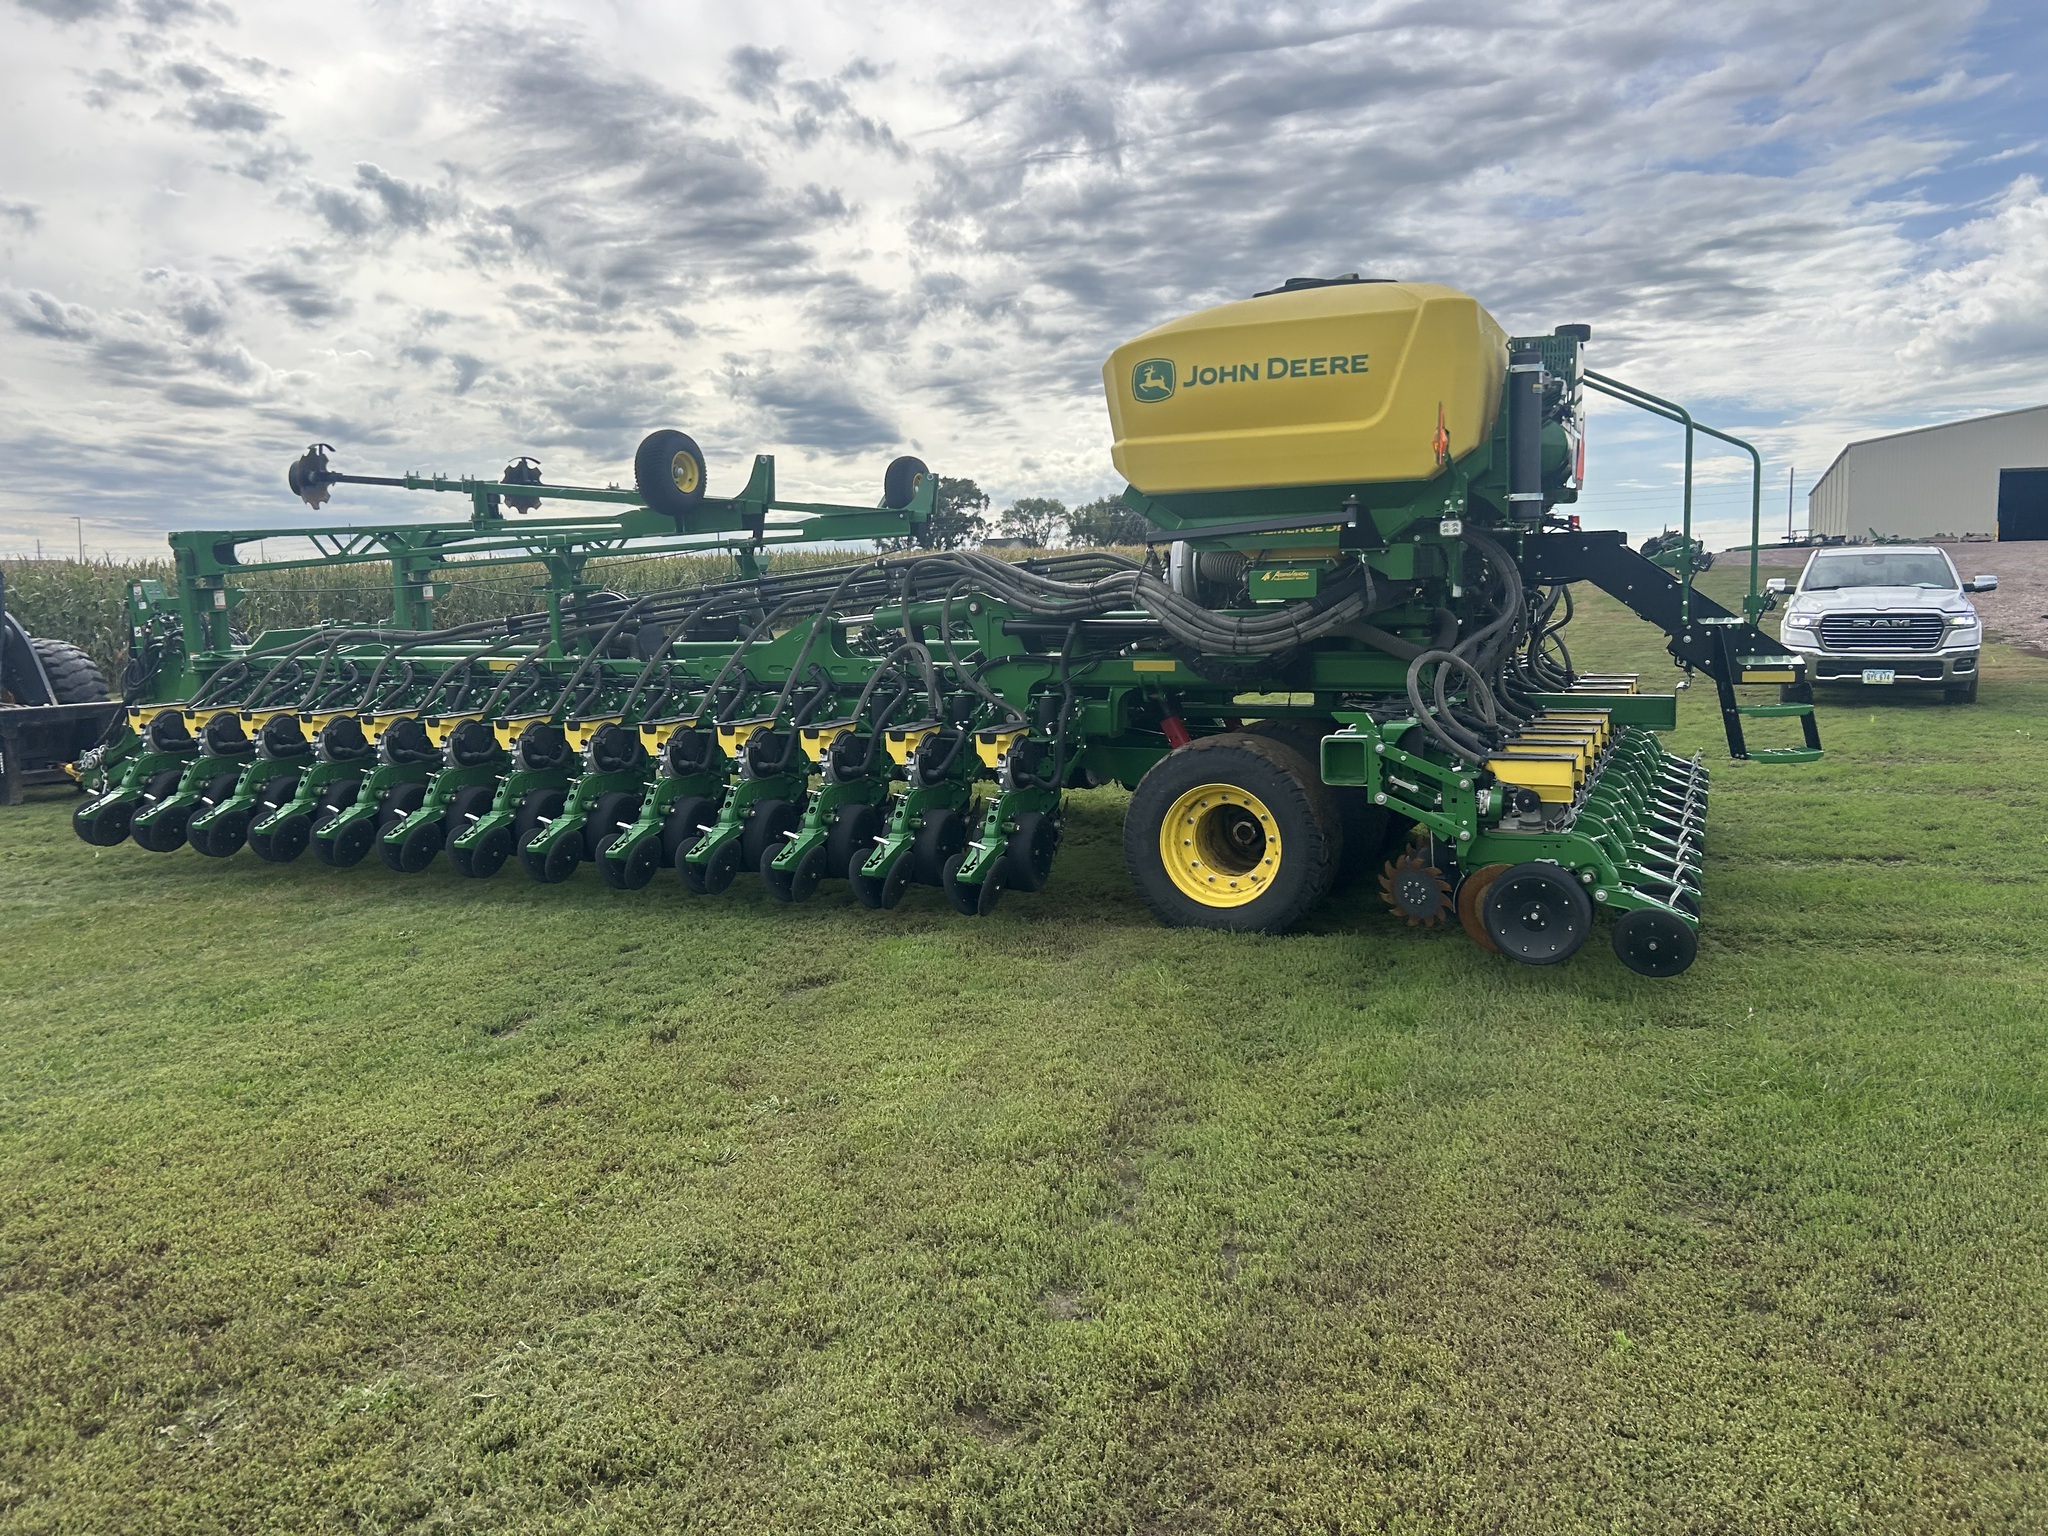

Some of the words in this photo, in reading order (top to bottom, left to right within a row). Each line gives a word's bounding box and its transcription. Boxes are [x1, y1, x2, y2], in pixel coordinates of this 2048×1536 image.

[1183, 363, 1259, 388] JOHN
[1267, 354, 1369, 380] DEERE
[1853, 619, 1910, 627] RAM
